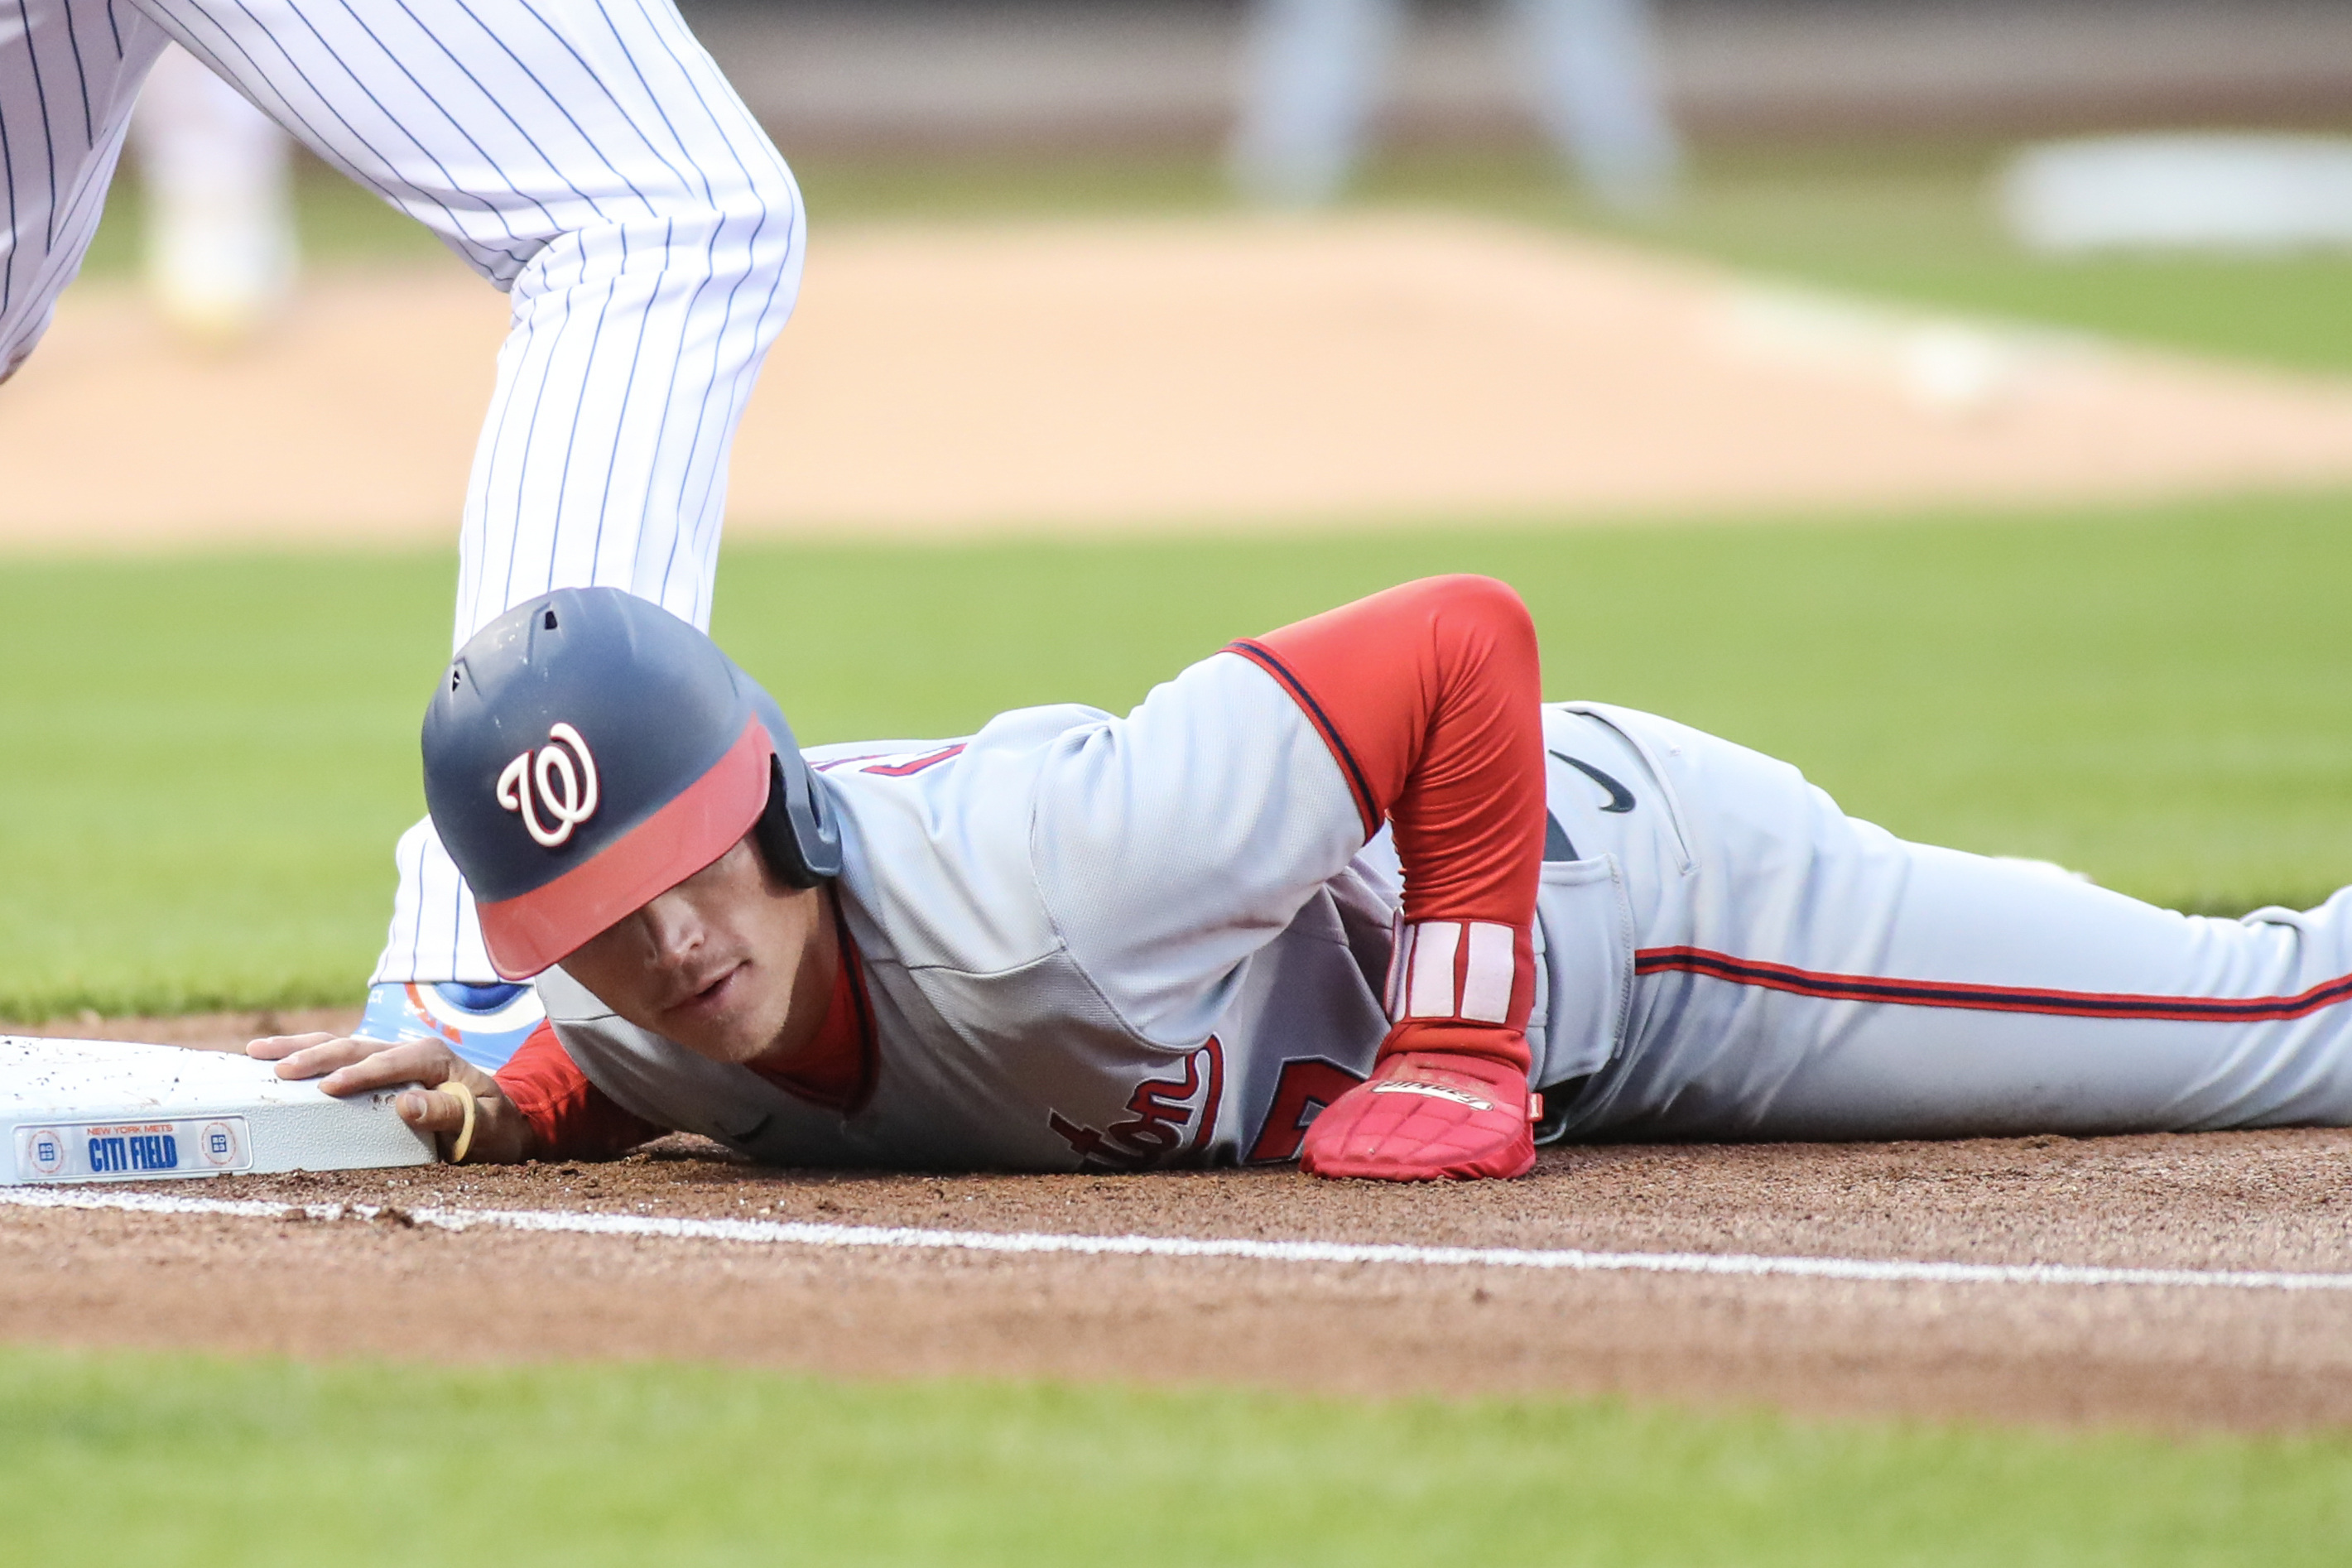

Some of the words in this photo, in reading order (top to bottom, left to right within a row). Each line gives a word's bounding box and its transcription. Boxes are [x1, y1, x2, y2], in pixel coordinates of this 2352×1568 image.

[496, 722, 601, 847] W
[87, 1127, 111, 1136] NEW
[113, 1125, 140, 1134] YORK
[144, 1123, 173, 1133] METS
[89, 1136, 127, 1171] CITI
[130, 1135, 178, 1169] FIELD
